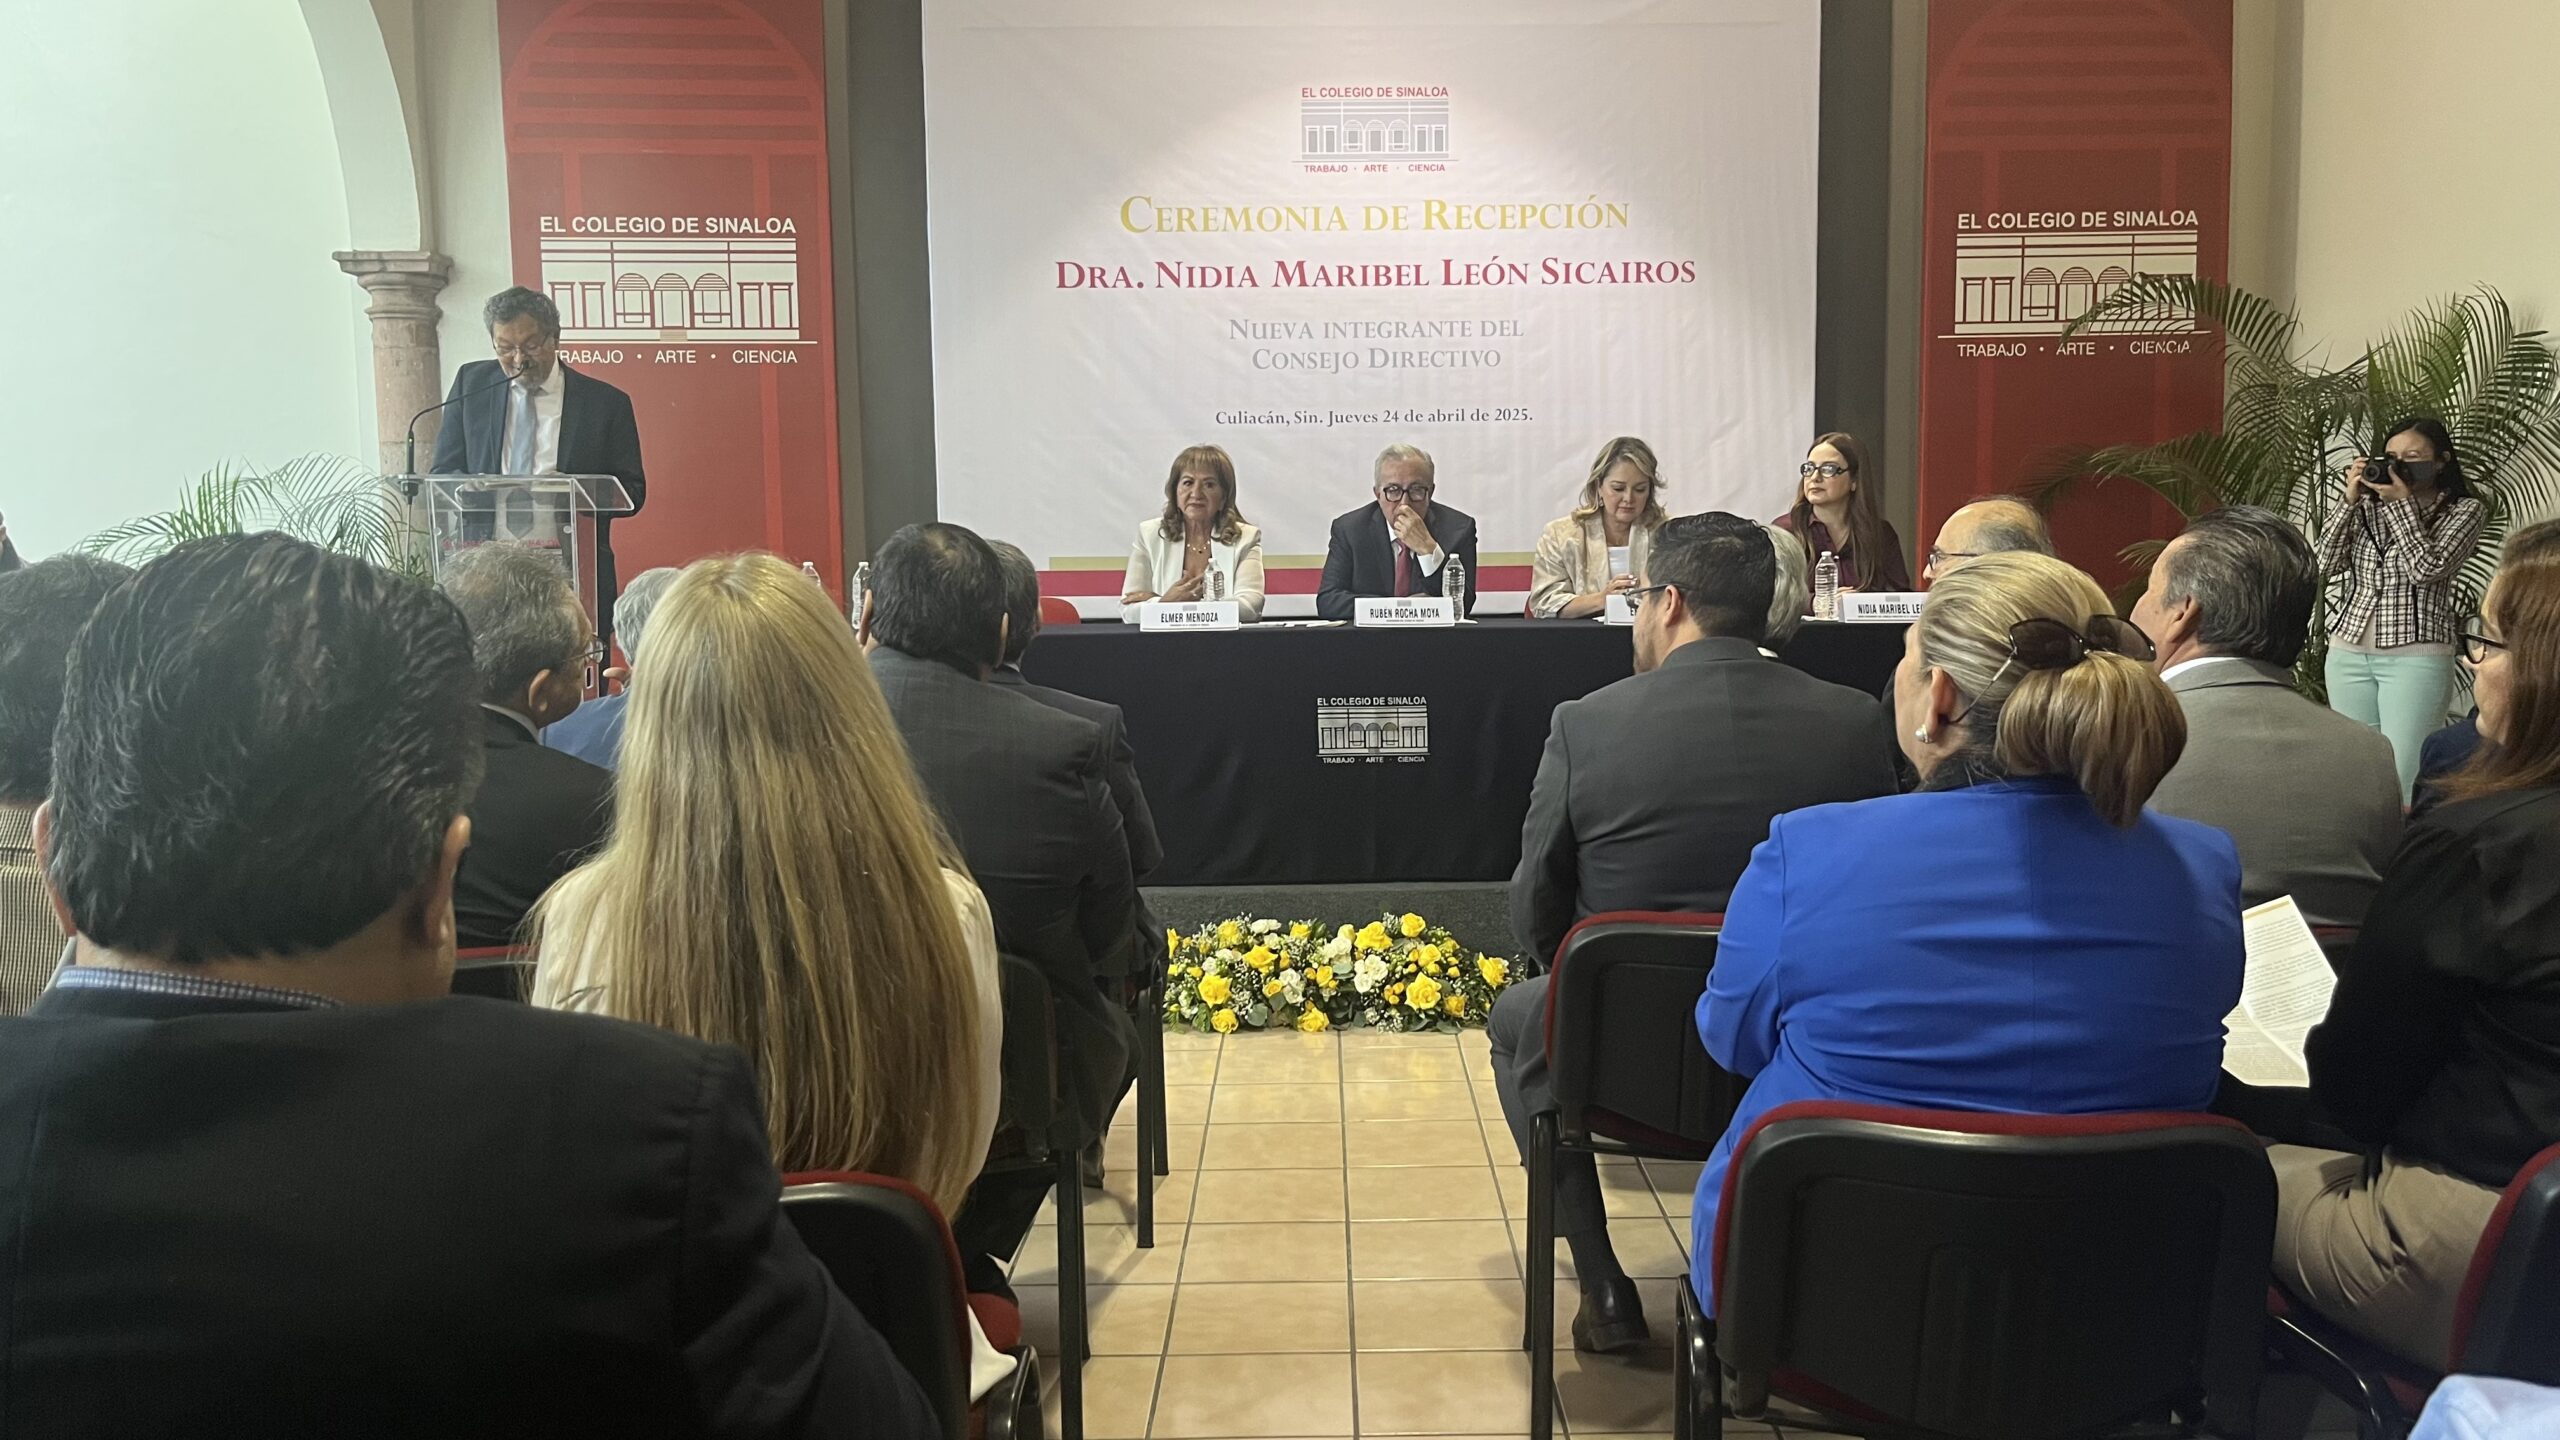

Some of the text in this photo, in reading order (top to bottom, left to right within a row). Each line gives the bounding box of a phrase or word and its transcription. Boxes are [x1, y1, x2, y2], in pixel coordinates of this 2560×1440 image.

[1302, 86, 1449, 98] EL COLEGIO DE SINALOA
[1304, 163, 1446, 173] TRABAJO ARTE CIENCIA
[541, 217, 796, 234] EL COLEGIO DE SINALOA
[1957, 210, 2199, 229] EL COLEGIO DE SINALOA
[1957, 340, 2191, 357] TRABAJO ARTE CIENCIA
[654, 350, 697, 364] ARTE
[732, 350, 798, 364] CIENCIA
[1215, 408, 1533, 427] Culiacán, Sin. Jueves 24 de abril de 2025.
[1394, 608, 1418, 618] ROCHA
[1420, 608, 1440, 618] MOYA
[1857, 604, 1877, 614] NIDIA
[1879, 604, 1910, 614] MARIBEL
[1161, 612, 1219, 623] ELMER MENDOZA
[1317, 696, 1427, 706] EL COLEGIO DE SINALOA
